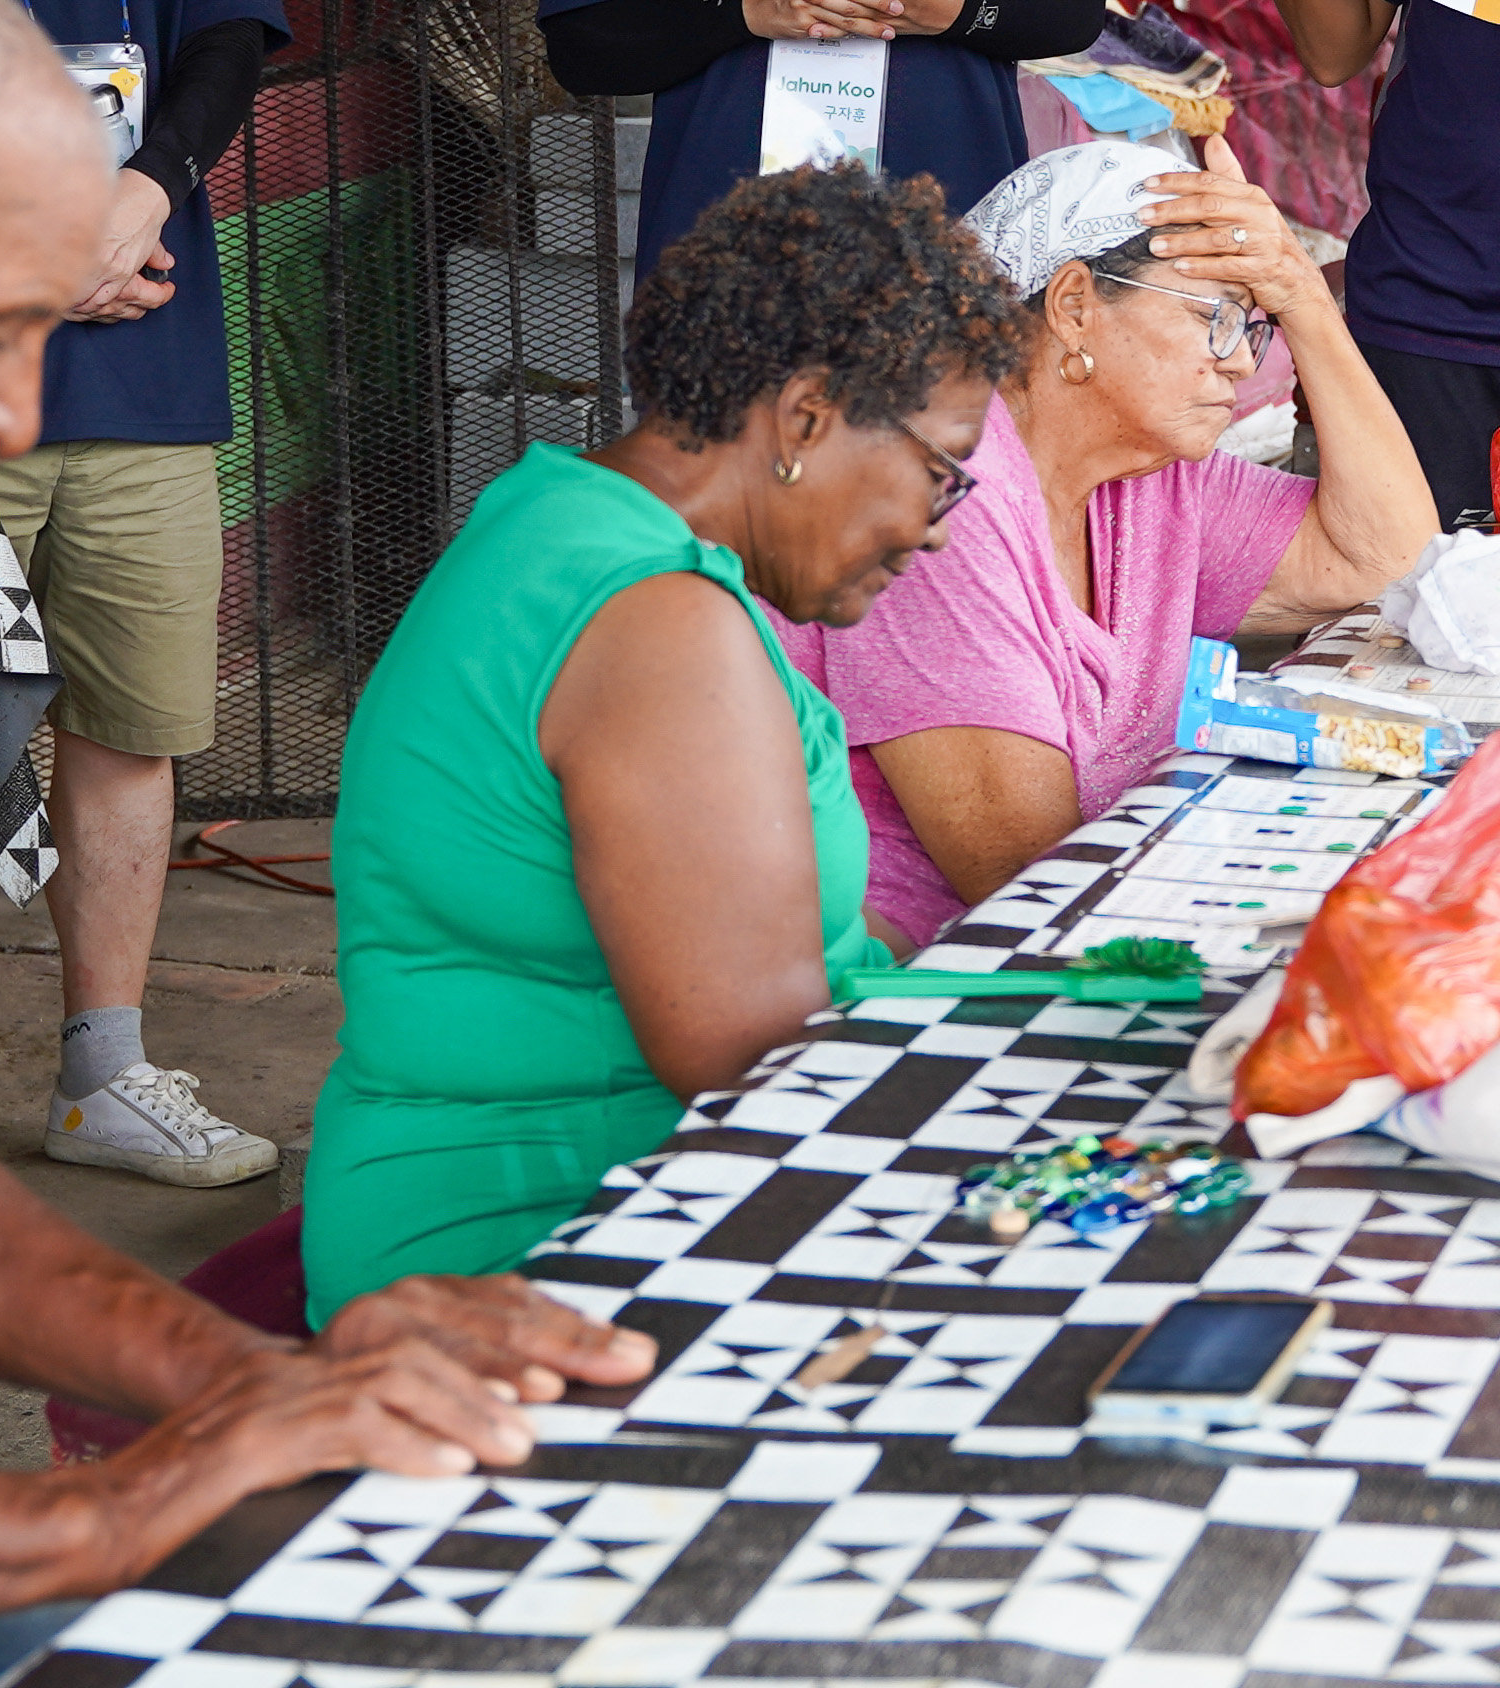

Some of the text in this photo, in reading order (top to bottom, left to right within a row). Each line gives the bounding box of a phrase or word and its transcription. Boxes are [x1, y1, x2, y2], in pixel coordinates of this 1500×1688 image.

[775, 76, 875, 98] Jahun Koo
[823, 105, 866, 123] 구자훈
